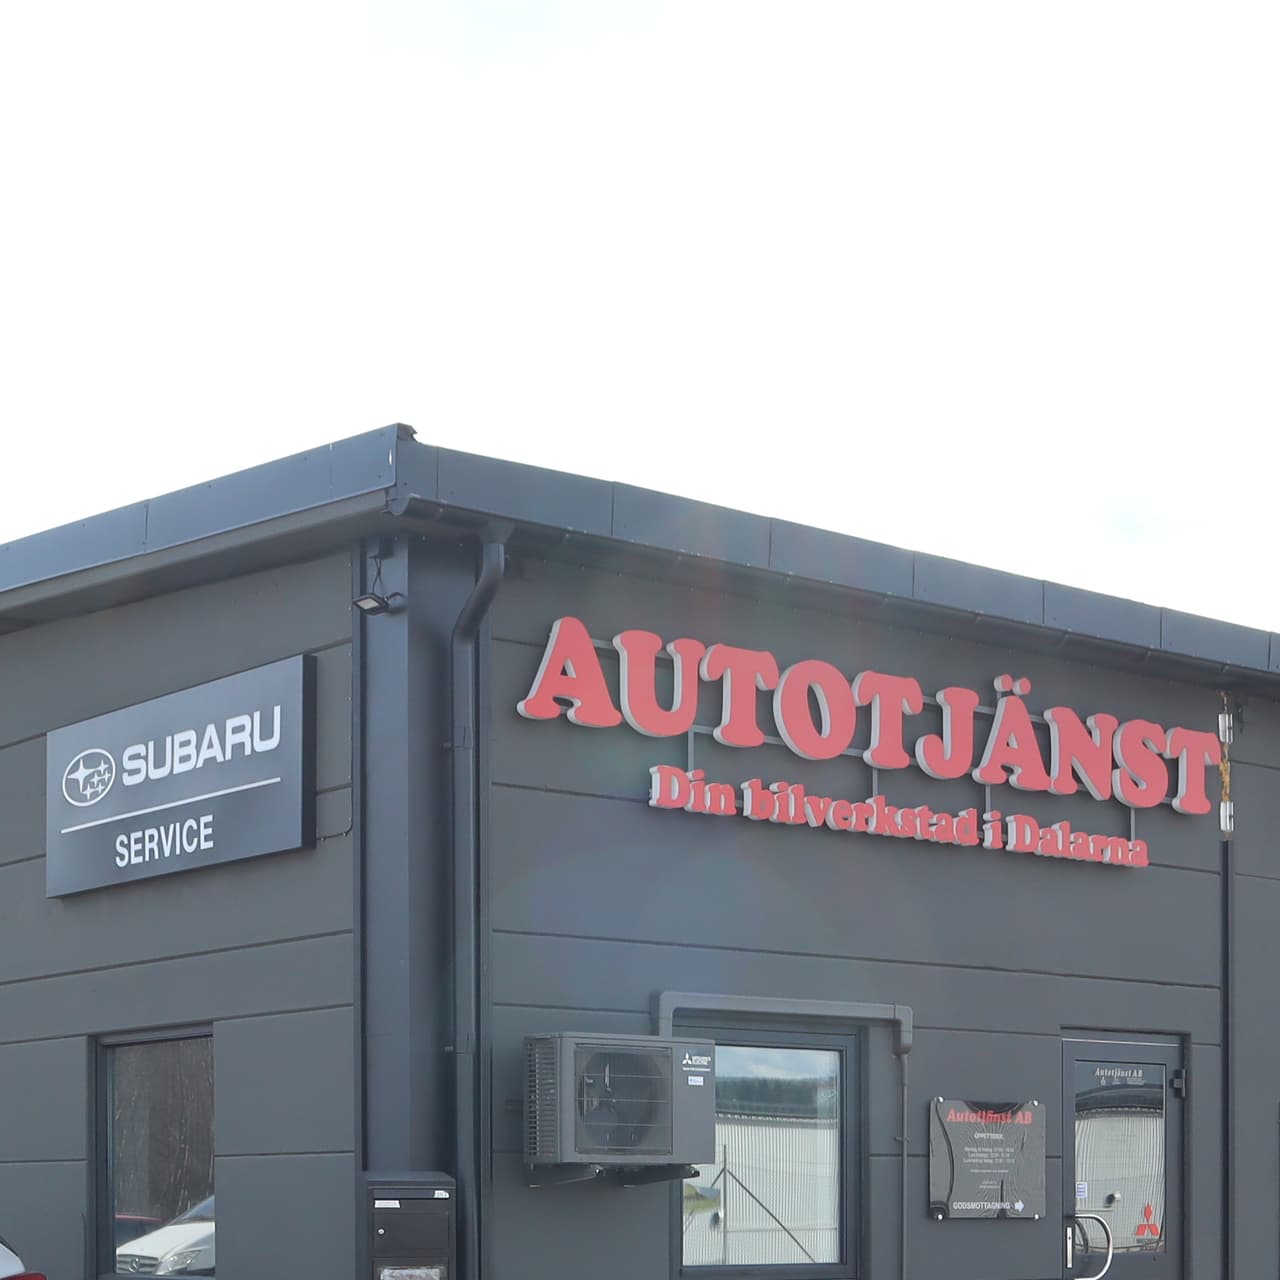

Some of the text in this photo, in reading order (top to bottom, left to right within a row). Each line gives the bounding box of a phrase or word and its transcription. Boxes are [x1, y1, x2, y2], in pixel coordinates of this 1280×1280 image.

[122, 705, 281, 786] SUBARU
[516, 615, 1221, 816] AUTOTJÄNST
[115, 814, 214, 868] SERVICE
[649, 764, 1149, 867] Din bilverkstad i Dalarna
[1016, 1110, 1033, 1125] AB
